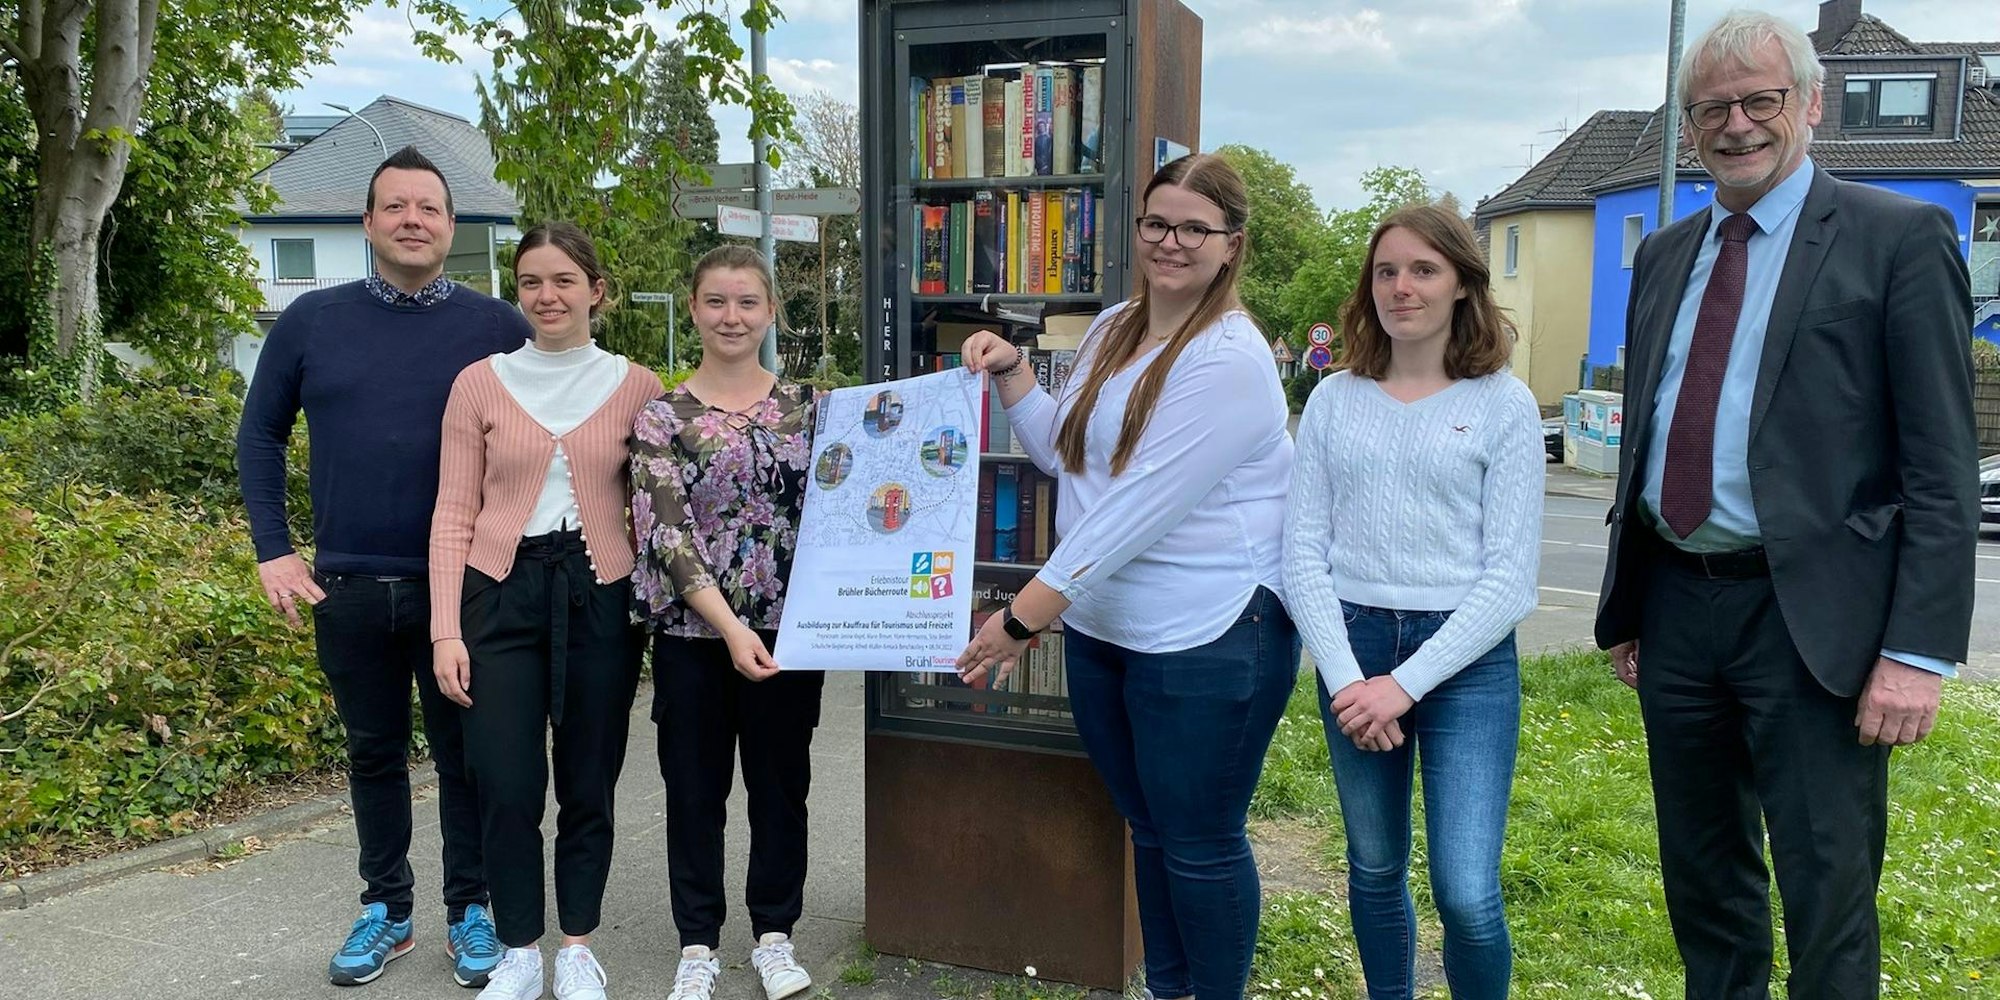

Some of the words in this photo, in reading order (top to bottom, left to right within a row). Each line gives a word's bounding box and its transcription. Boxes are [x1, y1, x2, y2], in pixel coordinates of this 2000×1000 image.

[1022, 137, 1033, 158] Das
[775, 192, 818, 201] Brühl-Heide
[883, 297, 892, 351] HIER
[1314, 330, 1328, 341] 30
[883, 364, 891, 382] Z
[870, 575, 908, 585] Erlebnistour
[838, 587, 863, 597] Brühler
[864, 586, 908, 596] Bücherroute
[797, 621, 831, 631] Ausbildung
[842, 621, 869, 629] Kauffrau
[871, 620, 881, 629] für
[881, 620, 913, 629] Tourismus
[915, 620, 928, 629] und
[928, 620, 953, 629] Freizeit
[904, 655, 932, 668] Brühl
